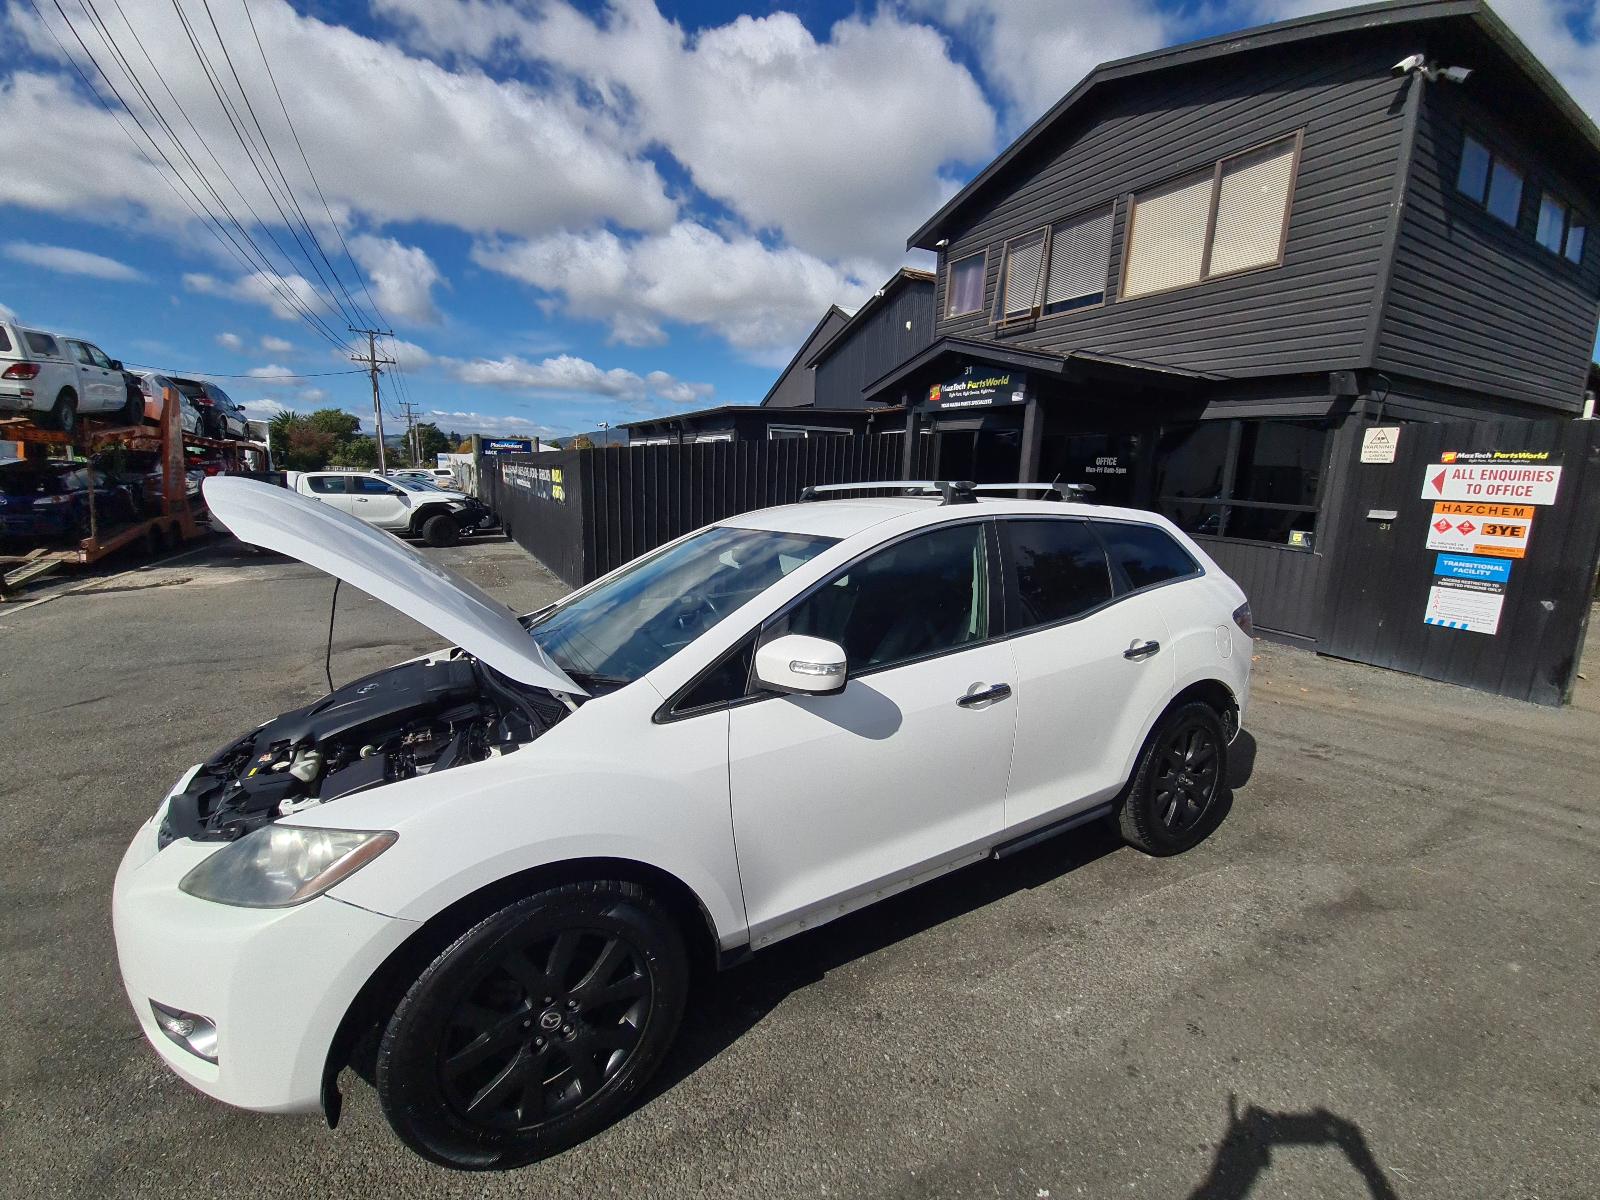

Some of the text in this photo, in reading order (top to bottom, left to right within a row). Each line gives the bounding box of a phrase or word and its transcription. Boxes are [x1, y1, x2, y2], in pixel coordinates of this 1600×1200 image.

[964, 366, 973, 375] 31
[967, 375, 1010, 389] PartsWorld
[1095, 457, 1118, 466] OFFICE
[1493, 452, 1549, 460] PartsWorld
[1451, 468, 1555, 482] ALL ENQUIRIES
[1466, 483, 1534, 497] TO OFFICE
[1441, 504, 1525, 517] HAZCHEM
[1379, 523, 1391, 531] 31
[1486, 525, 1521, 537] 3YE
[1443, 560, 1505, 571] TRANSITIONAL
[1453, 568, 1491, 576] FACILITY
